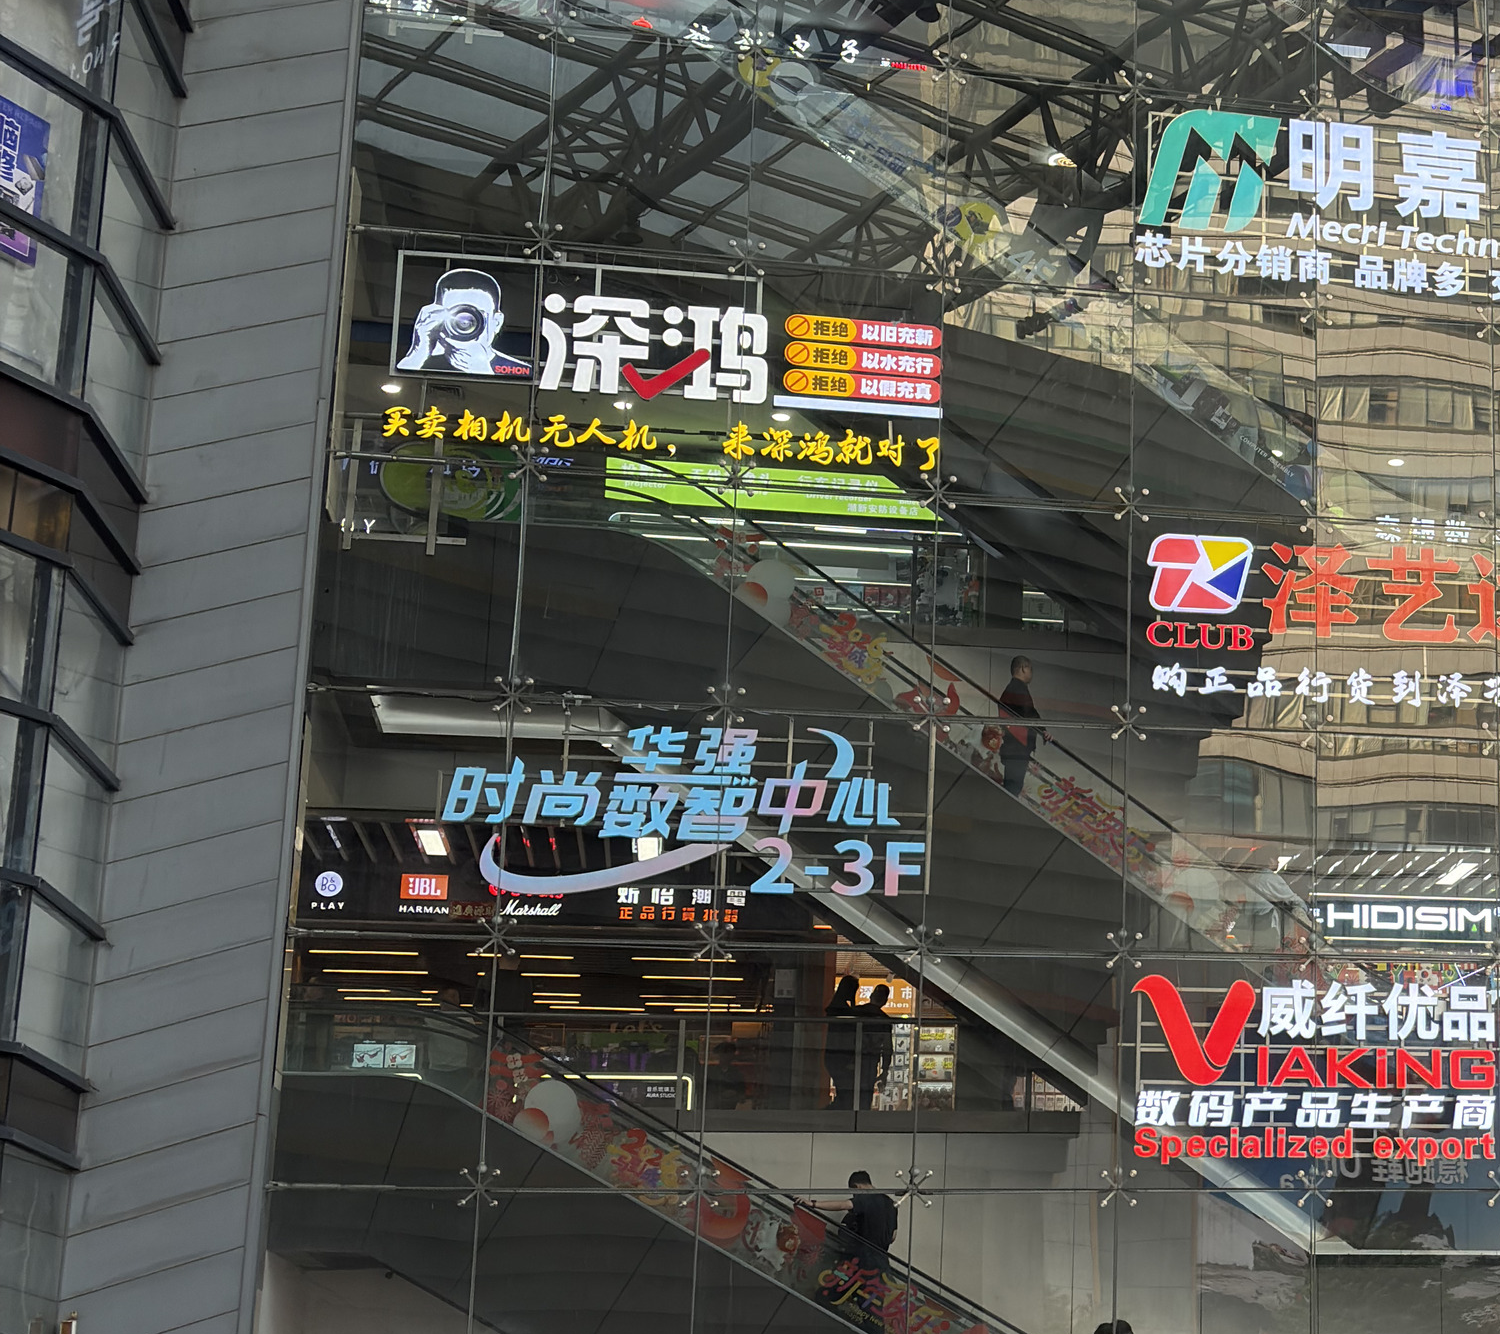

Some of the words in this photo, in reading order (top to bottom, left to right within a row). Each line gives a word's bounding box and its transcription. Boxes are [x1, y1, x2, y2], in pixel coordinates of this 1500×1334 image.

[1285, 212, 1388, 248] Mecri
[1136, 231, 1331, 286] 芯片分销商
[1354, 255, 1466, 298] 品牌多
[812, 319, 849, 338] 拒绝
[861, 323, 934, 347] 以旧充新
[539, 292, 769, 406] 深鸿
[812, 347, 849, 366] 拒绝
[861, 351, 934, 375] 以水充行
[494, 365, 530, 376] SOHON
[811, 374, 848, 393] 拒绝
[860, 378, 932, 401] 以假充真
[1146, 621, 1255, 651] CLUB
[622, 725, 759, 774] 华强
[442, 729, 900, 842] 时尚数智中心
[750, 835, 926, 897] 2-3F
[408, 877, 441, 897] JBL
[310, 901, 345, 911] PLAY
[399, 904, 450, 916] HARMAN
[499, 899, 563, 917] Marshall
[1326, 903, 1492, 933] HIDISIM
[859, 985, 913, 1000] 深市
[1256, 979, 1496, 1043] 威纤优品
[1133, 1089, 1497, 1131] 数码产品生产商
[1133, 1126, 1354, 1165] Specialized
[1372, 1132, 1497, 1166] export
